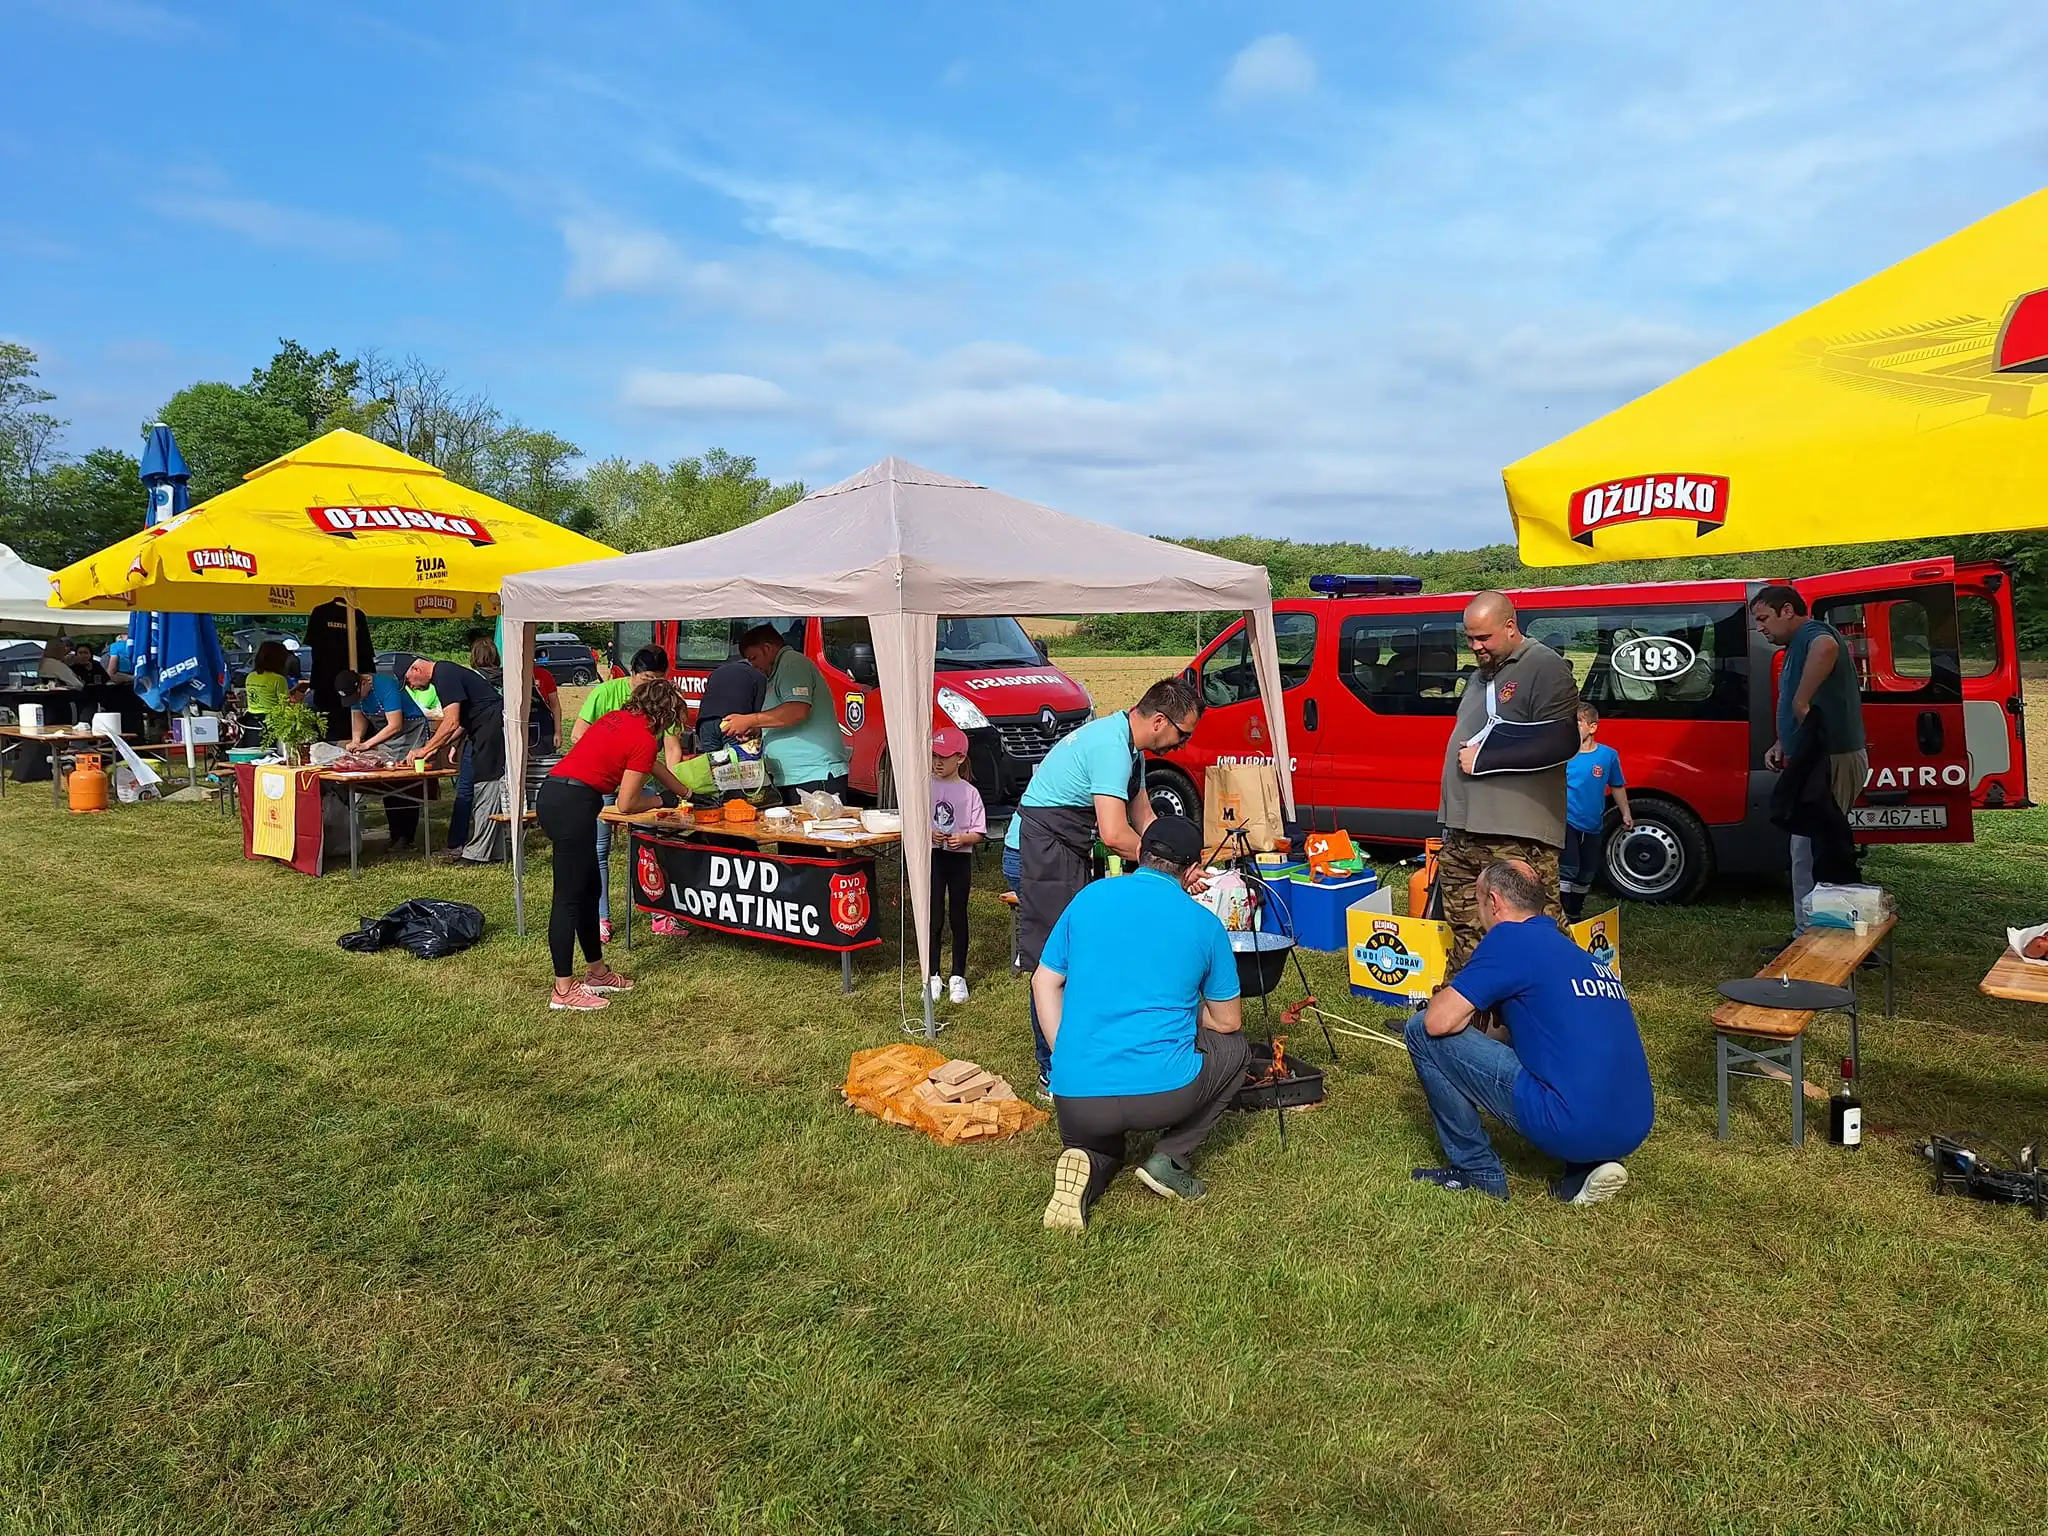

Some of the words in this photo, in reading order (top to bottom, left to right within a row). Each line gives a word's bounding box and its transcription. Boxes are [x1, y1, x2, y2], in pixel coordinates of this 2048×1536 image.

[1582, 476, 1714, 526] Ožujsko
[323, 507, 477, 537] Ožujsko
[415, 555, 446, 573] ŽUJA
[159, 656, 199, 683] PEPSI
[1629, 646, 1678, 672] 193
[1222, 807, 1236, 821] M
[1878, 808, 1942, 826] 467-EL
[709, 856, 779, 893] DVD
[839, 877, 860, 889] DVD
[670, 883, 820, 936] LOPATINEC
[1370, 935, 1402, 952] BUDI
[1357, 949, 1378, 961] BUDI
[1395, 957, 1419, 968] ZDRAV
